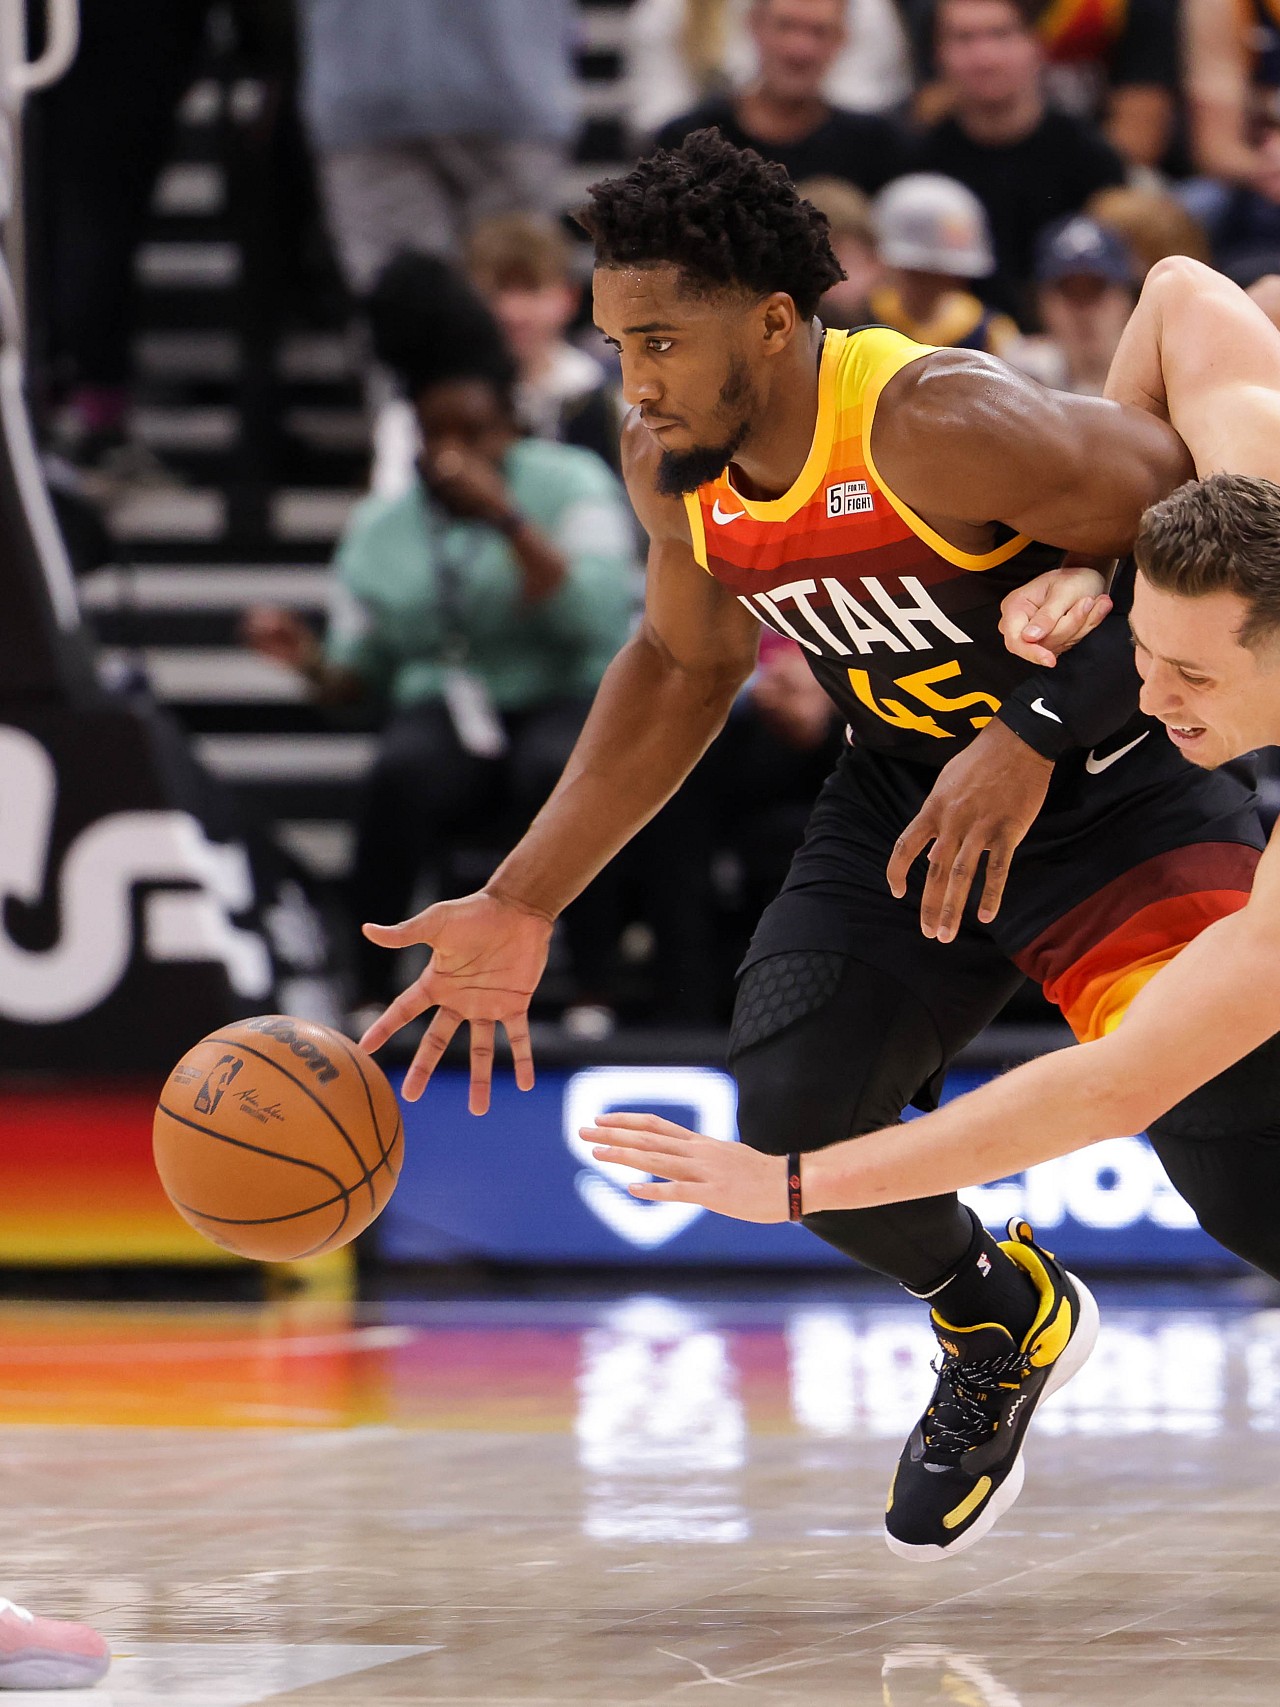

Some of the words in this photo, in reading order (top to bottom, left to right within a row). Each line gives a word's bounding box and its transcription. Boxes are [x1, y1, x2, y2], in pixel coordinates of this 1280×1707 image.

[830, 486, 842, 514] 5
[847, 496, 871, 511] FIGHT
[736, 576, 974, 656] UTAH
[847, 659, 1002, 738] 45
